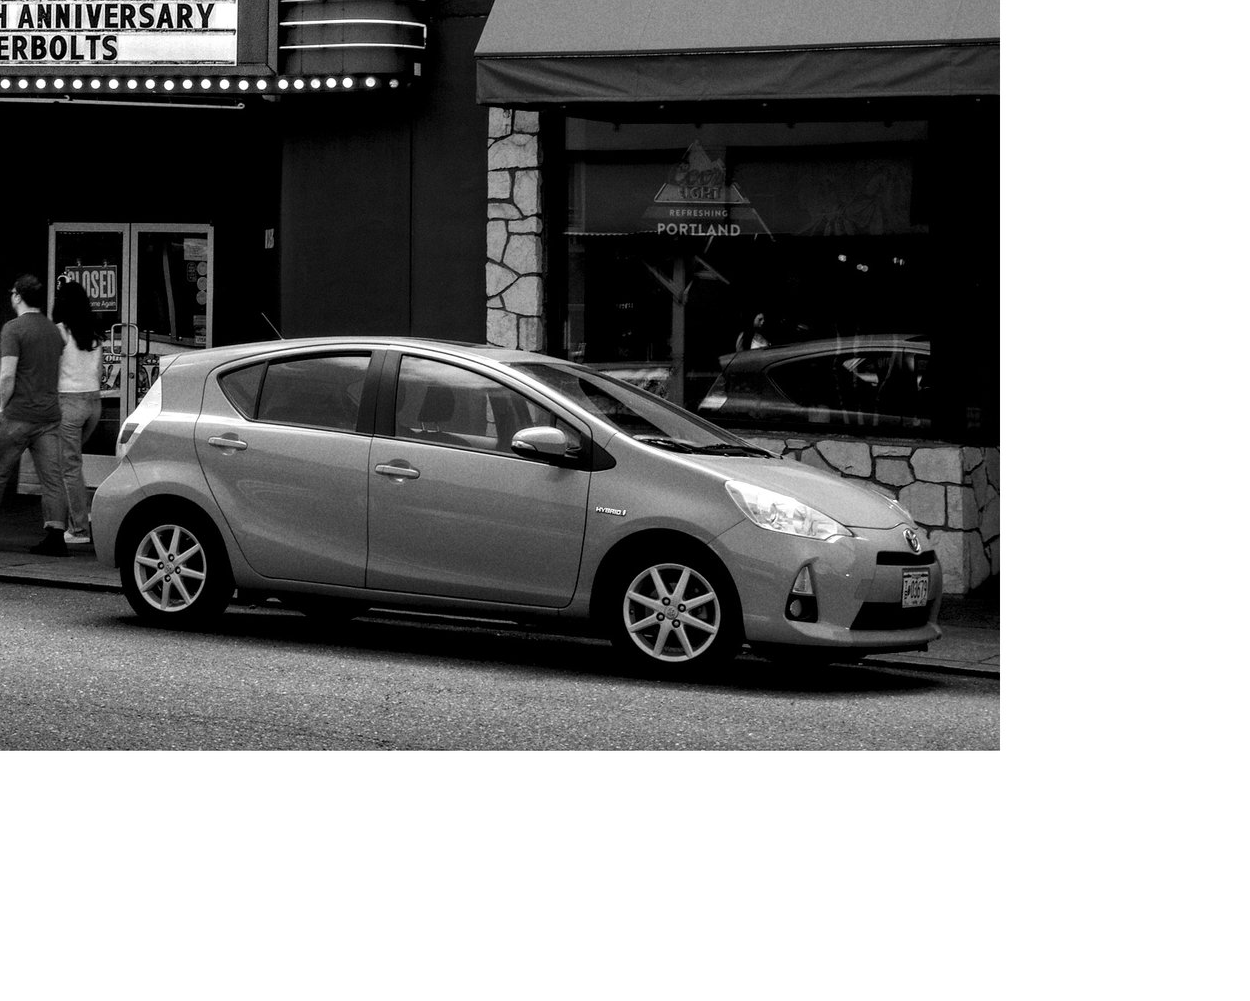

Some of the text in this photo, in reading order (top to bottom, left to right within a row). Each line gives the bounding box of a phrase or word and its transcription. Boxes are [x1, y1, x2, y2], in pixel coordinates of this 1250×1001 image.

[17, 2, 215, 29] ANNIVERSARY
[669, 208, 729, 218] REFRESHING
[657, 222, 741, 237] PORTLAND
